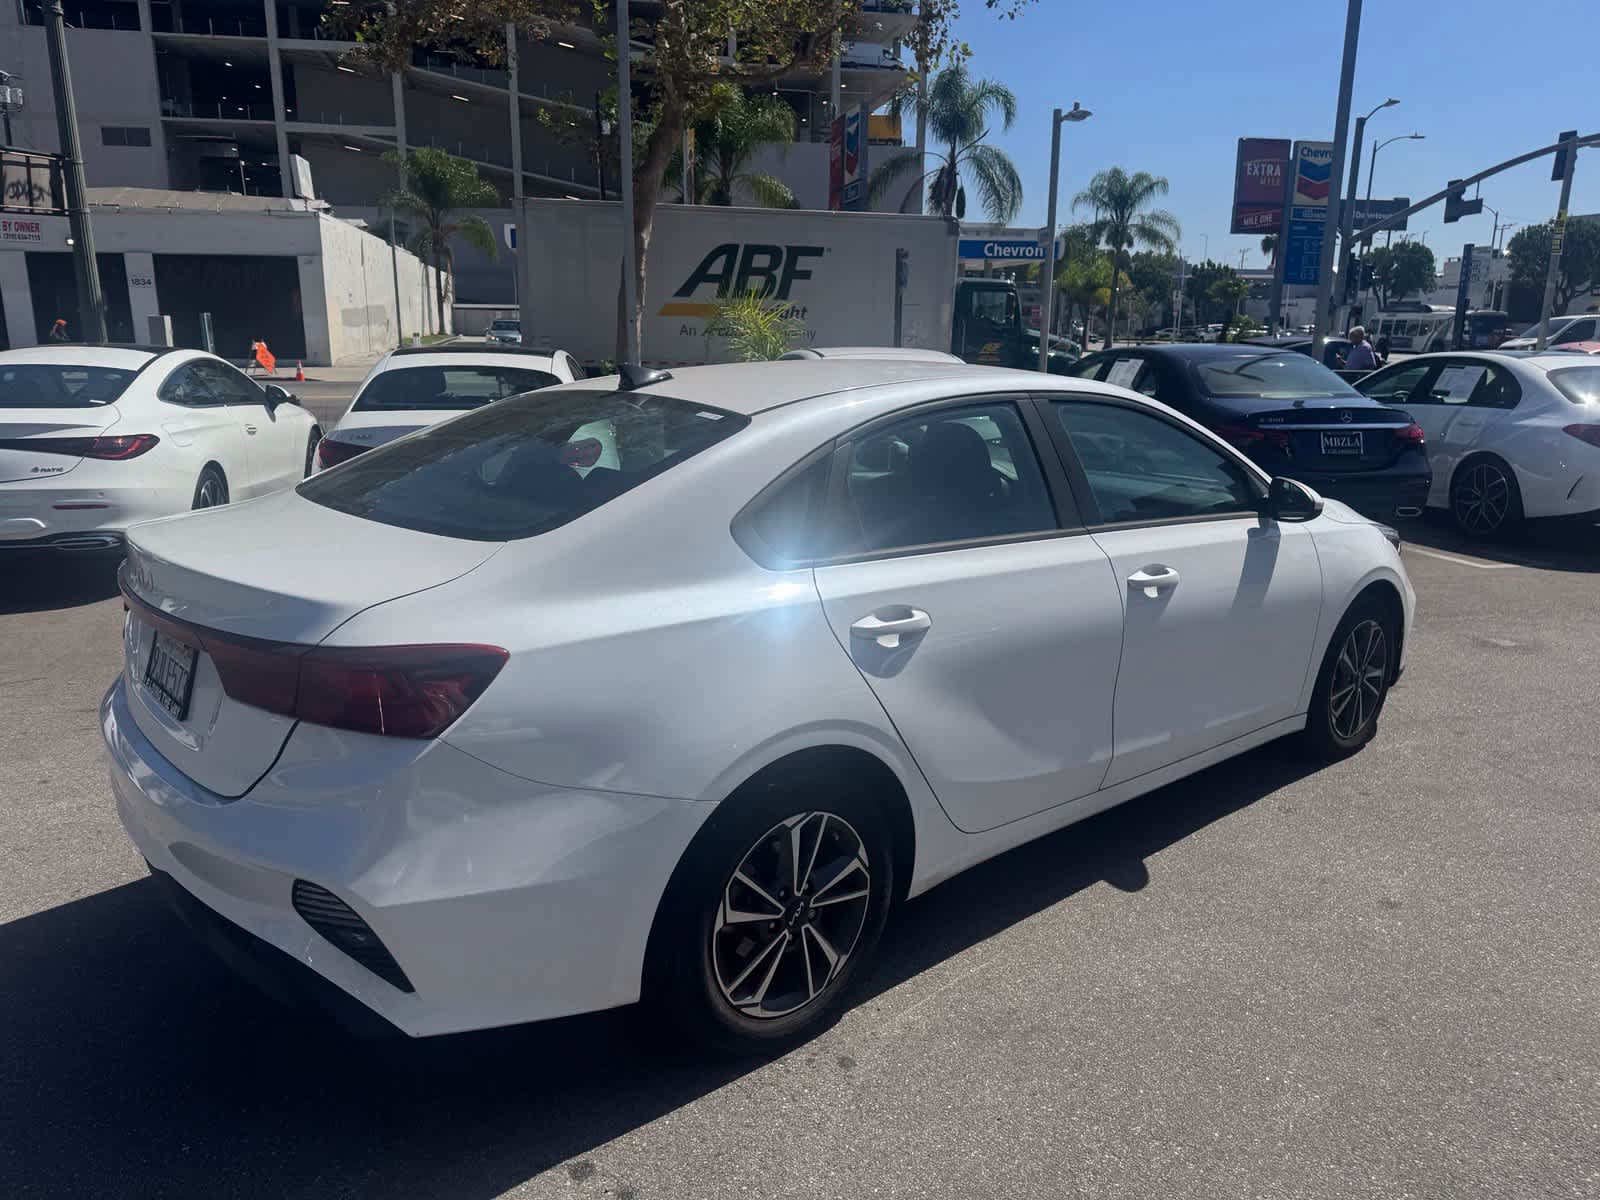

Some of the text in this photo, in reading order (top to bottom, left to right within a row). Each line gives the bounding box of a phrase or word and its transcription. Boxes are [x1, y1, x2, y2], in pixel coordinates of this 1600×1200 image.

[1246, 163, 1281, 177] EXTRA
[2, 220, 40, 233] BY OWNER
[983, 242, 1045, 257] Chevron
[672, 243, 825, 301] ABF
[131, 278, 152, 287] 1834
[679, 323, 698, 337] An
[1323, 436, 1360, 448] MBZLA
